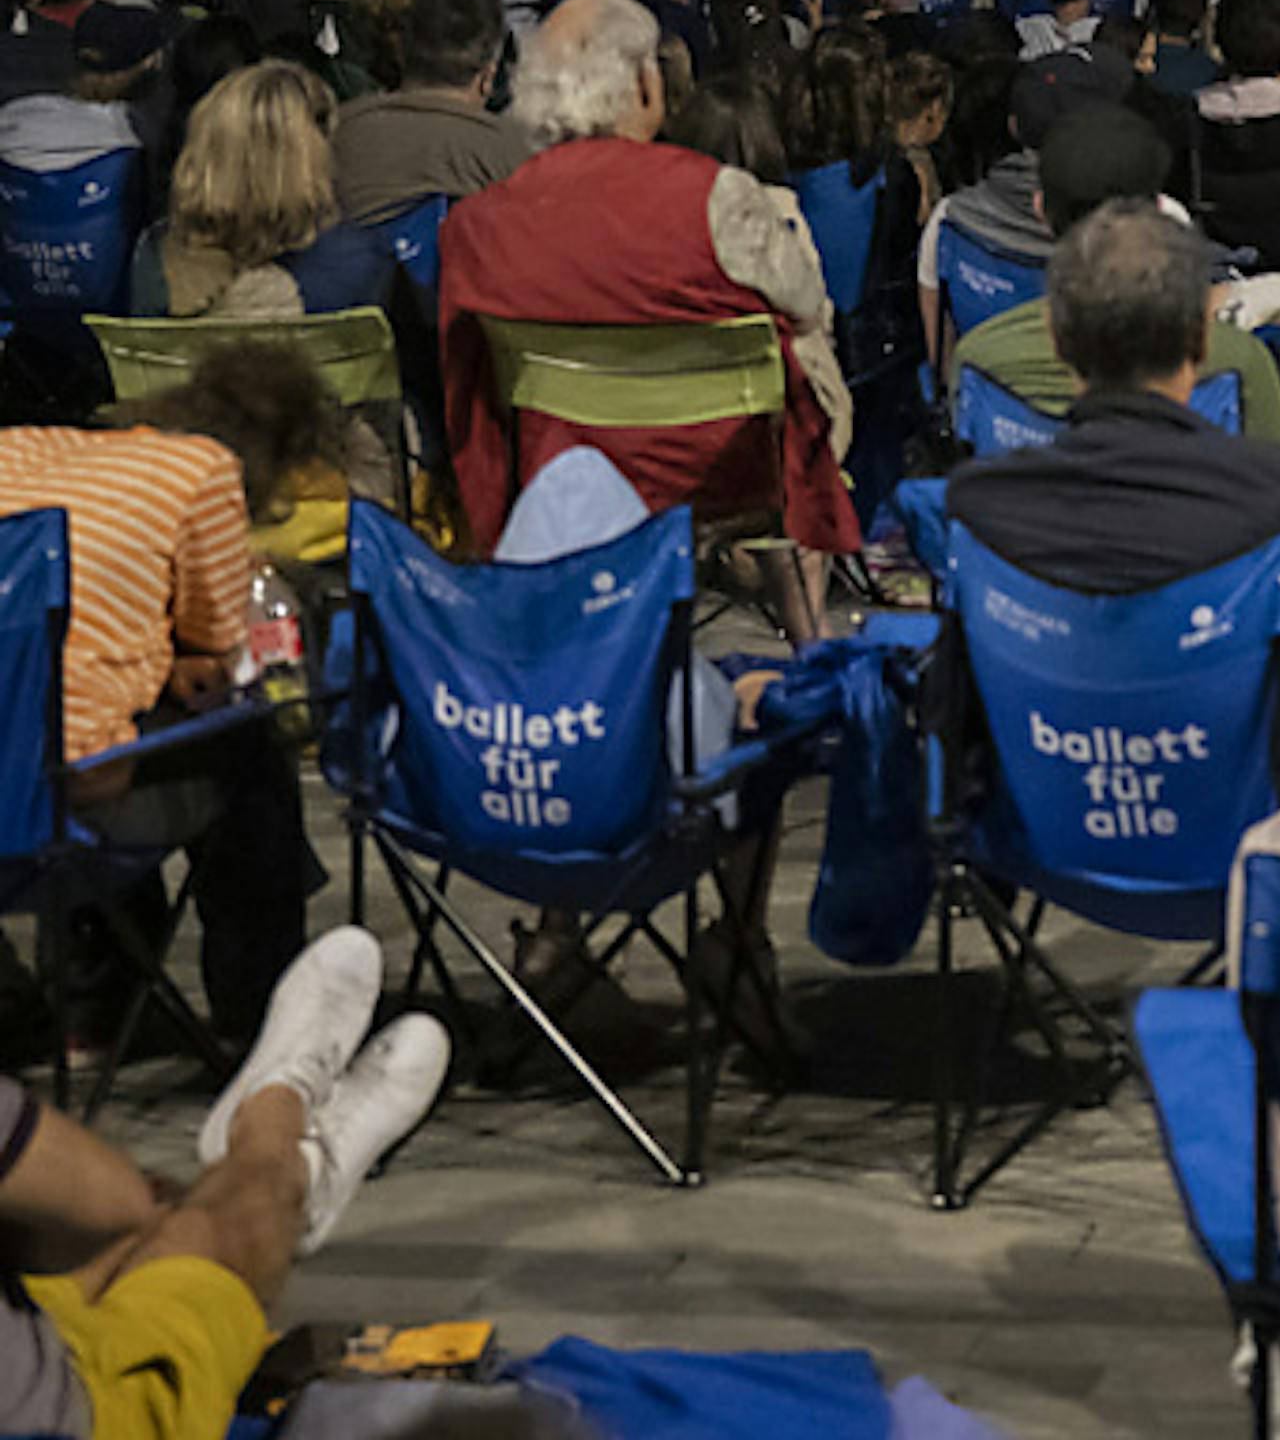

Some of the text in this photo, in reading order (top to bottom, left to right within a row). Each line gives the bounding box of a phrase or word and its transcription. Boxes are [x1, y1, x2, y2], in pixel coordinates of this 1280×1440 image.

[433, 680, 606, 748] ballett
[1028, 710, 1210, 765] ballett
[480, 746, 561, 790] für
[1083, 762, 1166, 803] für
[480, 790, 572, 828] alle
[1084, 803, 1179, 840] alle
